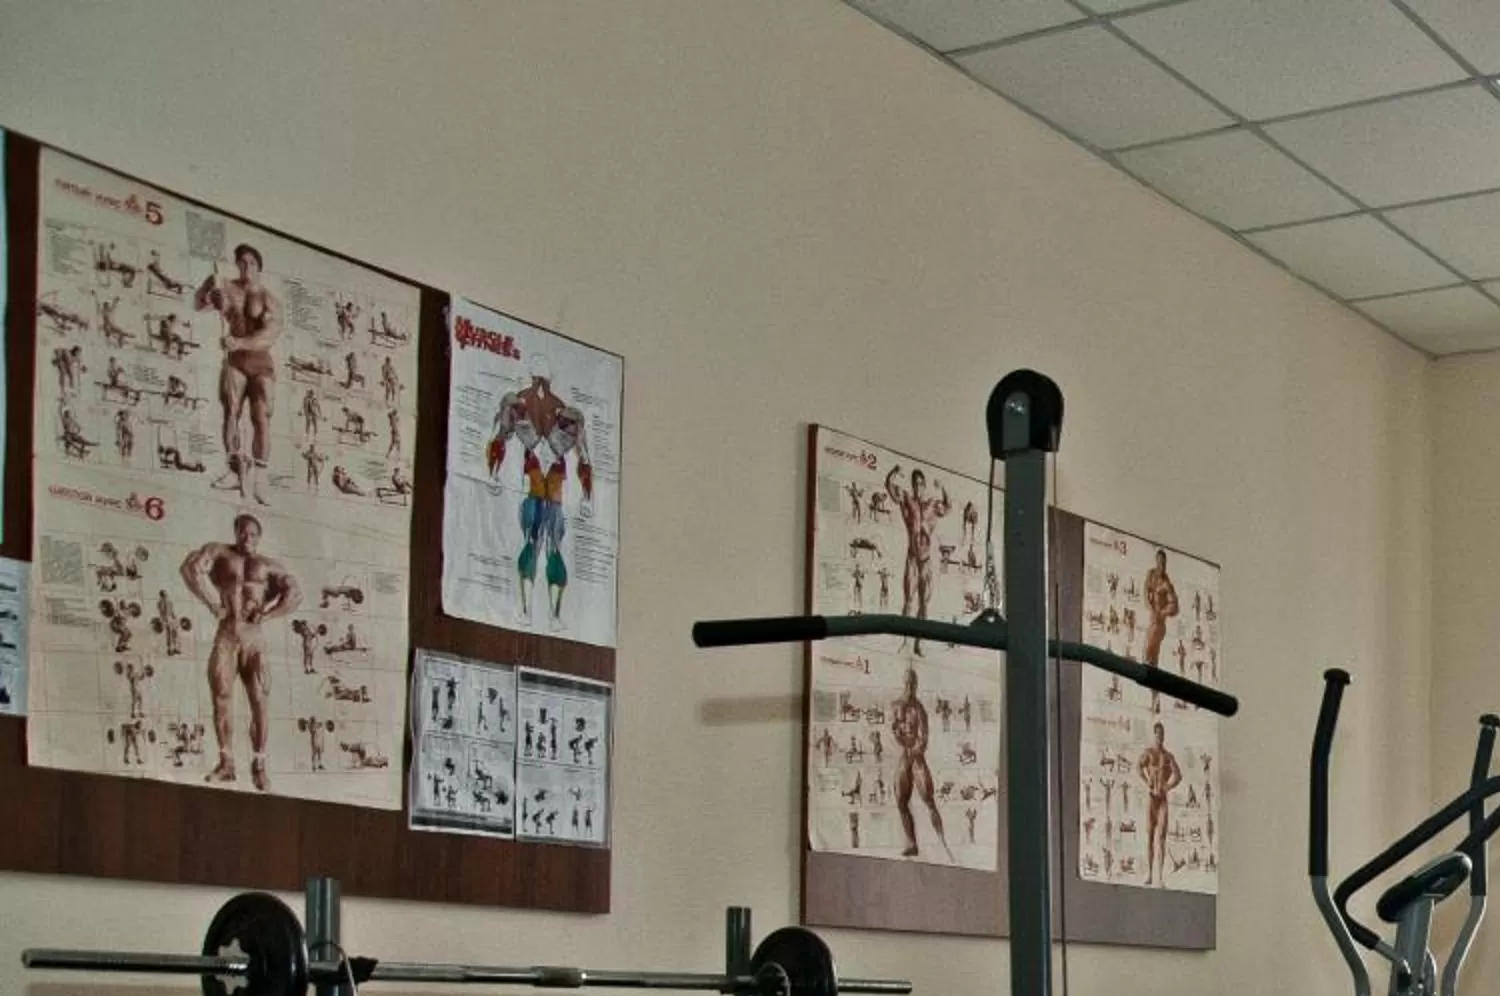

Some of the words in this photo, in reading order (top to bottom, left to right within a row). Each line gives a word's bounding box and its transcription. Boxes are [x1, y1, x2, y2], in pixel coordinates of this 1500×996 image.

[145, 201, 164, 225] 5
[867, 453, 877, 470] 2
[144, 497, 165, 521] 6
